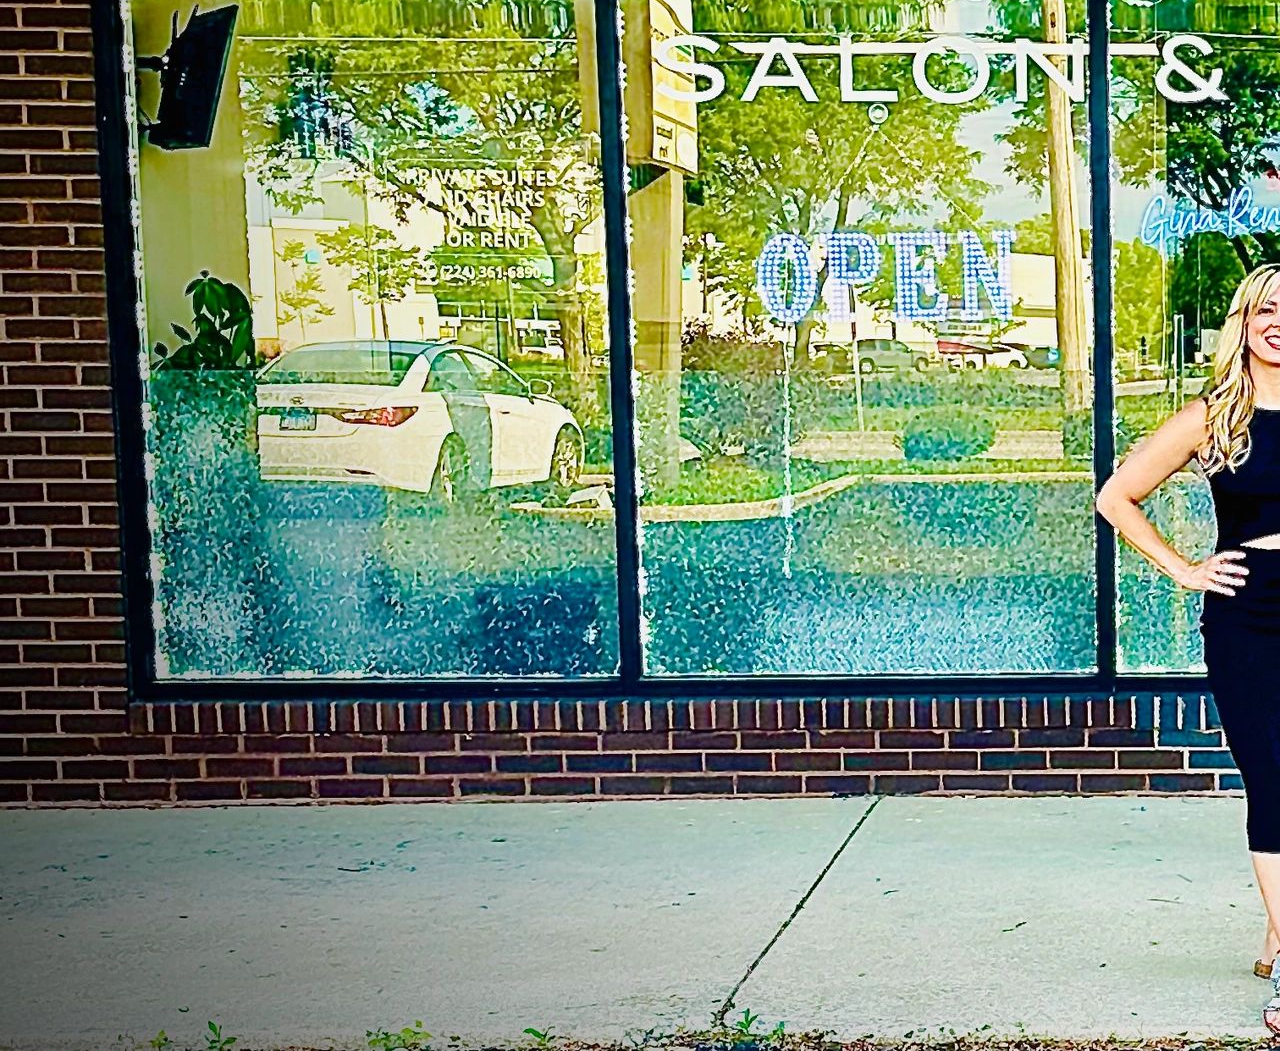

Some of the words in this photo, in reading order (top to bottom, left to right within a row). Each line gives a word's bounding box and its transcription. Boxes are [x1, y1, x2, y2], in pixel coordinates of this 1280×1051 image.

[653, 35, 1088, 104] SALON
[1154, 34, 1230, 103] &
[406, 167, 487, 186] PRIVATE
[488, 169, 557, 187] SUITES
[425, 189, 467, 207] ND
[474, 189, 545, 208] CHAIRS
[438, 211, 531, 229] VAILABLE
[1140, 194, 1222, 252] Gina
[438, 230, 475, 249] OR
[481, 231, 530, 249] RENT
[756, 228, 1018, 324] OPEN
